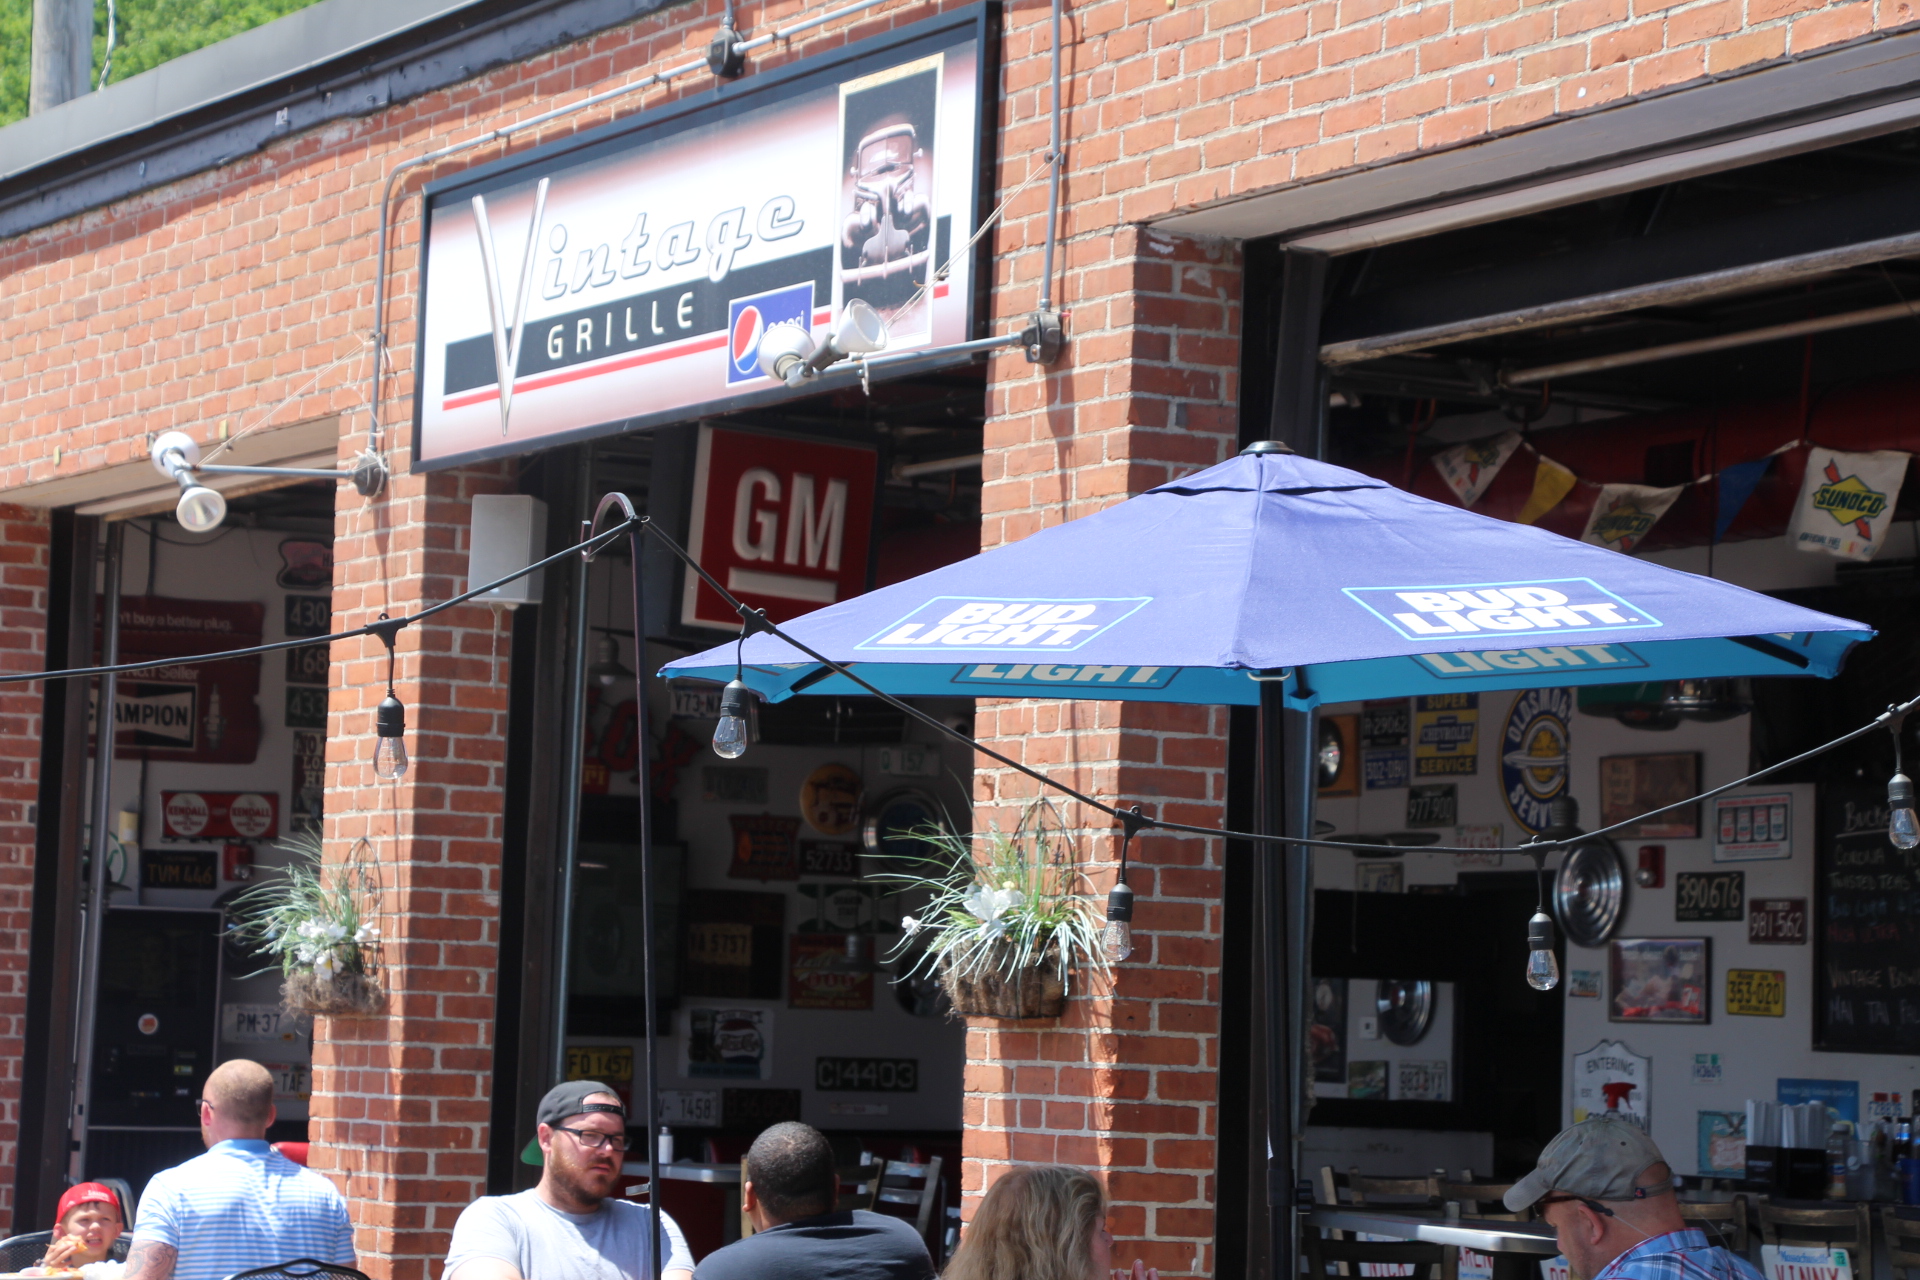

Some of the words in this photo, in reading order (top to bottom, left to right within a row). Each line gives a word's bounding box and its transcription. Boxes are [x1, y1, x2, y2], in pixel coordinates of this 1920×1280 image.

[472, 177, 803, 436] Vintage
[547, 291, 694, 360] GRILLE
[1817, 488, 1883, 514] SUNOCO
[732, 467, 849, 572] GM
[1395, 587, 1568, 612] BUD
[938, 602, 1096, 625] BUD
[1393, 603, 1628, 634] LIGHT
[877, 623, 1098, 646] LIGHT
[1421, 644, 1620, 673] LIGHT
[969, 664, 1160, 684] LIGHT
[1421, 758, 1473, 773] SERVICE
[168, 806, 207, 817] KENDALL
[231, 807, 270, 818] KENDALL
[148, 864, 180, 882] TVM
[183, 865, 212, 885] 446
[1729, 981, 1781, 1004] 353-020
[1586, 1056, 1634, 1076] ENTERING
